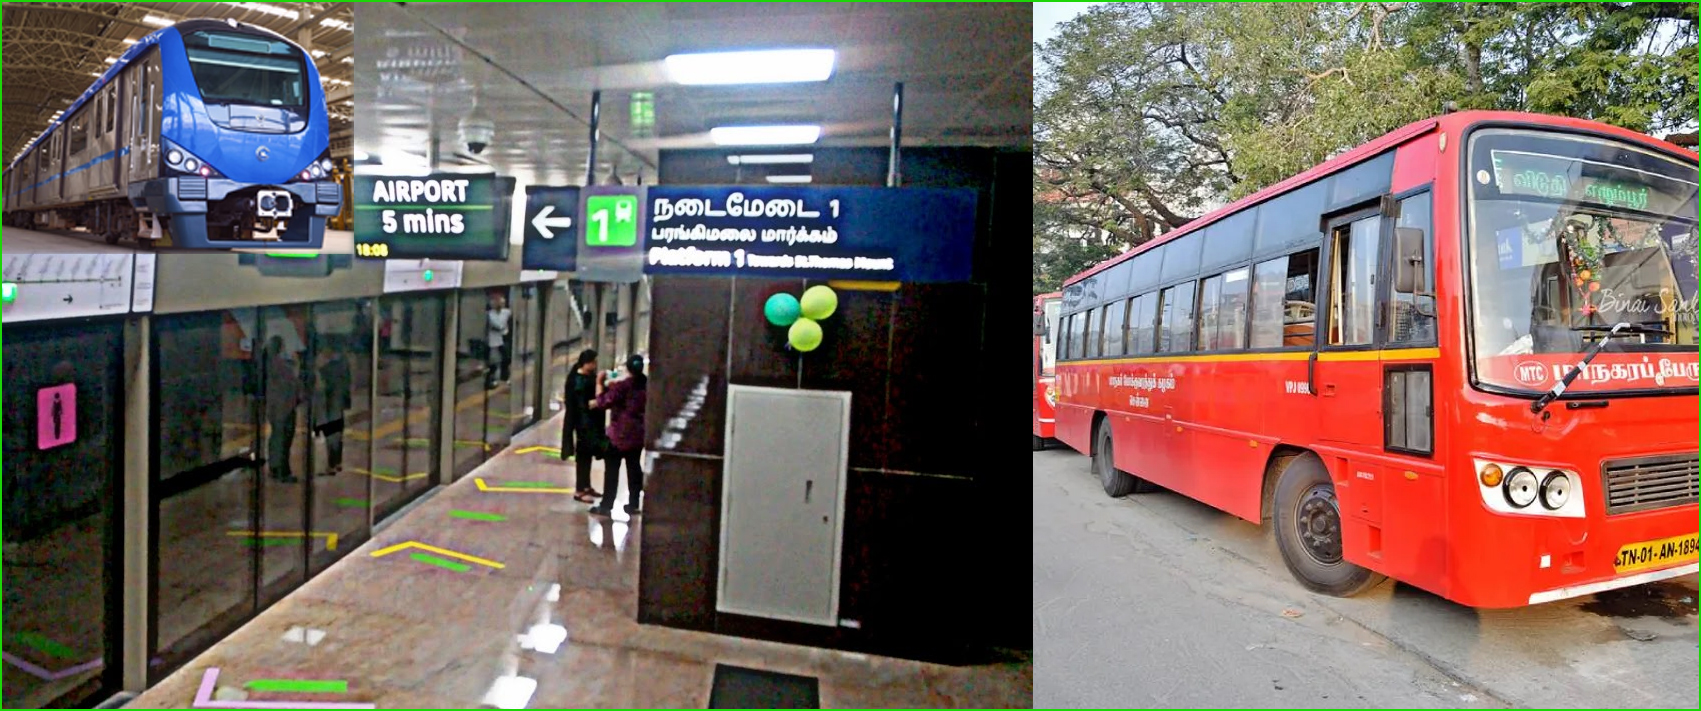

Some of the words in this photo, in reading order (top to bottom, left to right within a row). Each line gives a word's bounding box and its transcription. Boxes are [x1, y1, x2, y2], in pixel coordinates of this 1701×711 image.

[373, 180, 469, 203] AIRPORT
[653, 191, 820, 222] நடைமேடை
[829, 199, 840, 218] 1
[382, 210, 398, 233] 5
[403, 208, 465, 234] mins
[591, 208, 610, 242] 1
[651, 224, 757, 243] பரங்கிமலை
[761, 226, 838, 246] மார்க்கம்
[733, 248, 746, 268] 1
[1519, 365, 1545, 382] MTC
